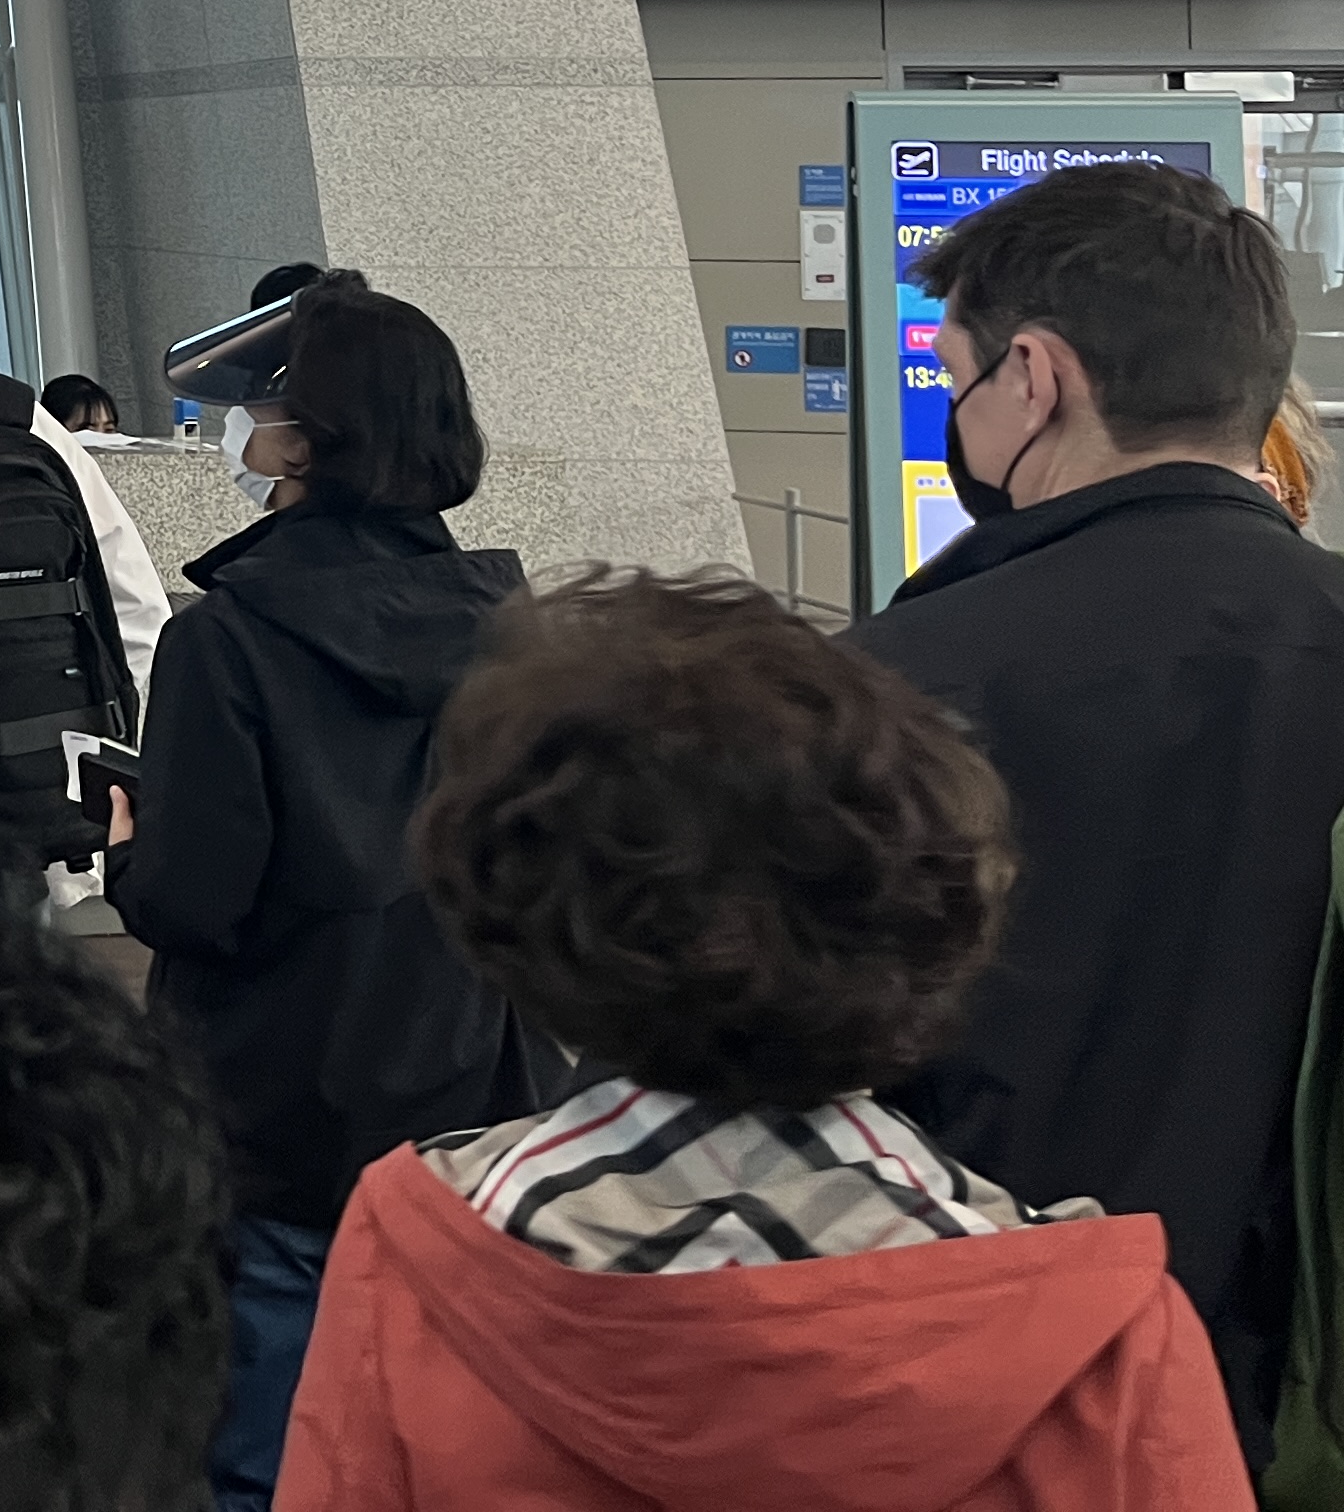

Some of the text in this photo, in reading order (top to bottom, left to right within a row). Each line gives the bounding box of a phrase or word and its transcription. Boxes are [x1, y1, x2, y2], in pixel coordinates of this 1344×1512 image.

[981, 148, 1048, 176] Flight
[953, 188, 980, 205] BX
[898, 225, 944, 248] 07:5
[904, 366, 953, 389] 13:4
